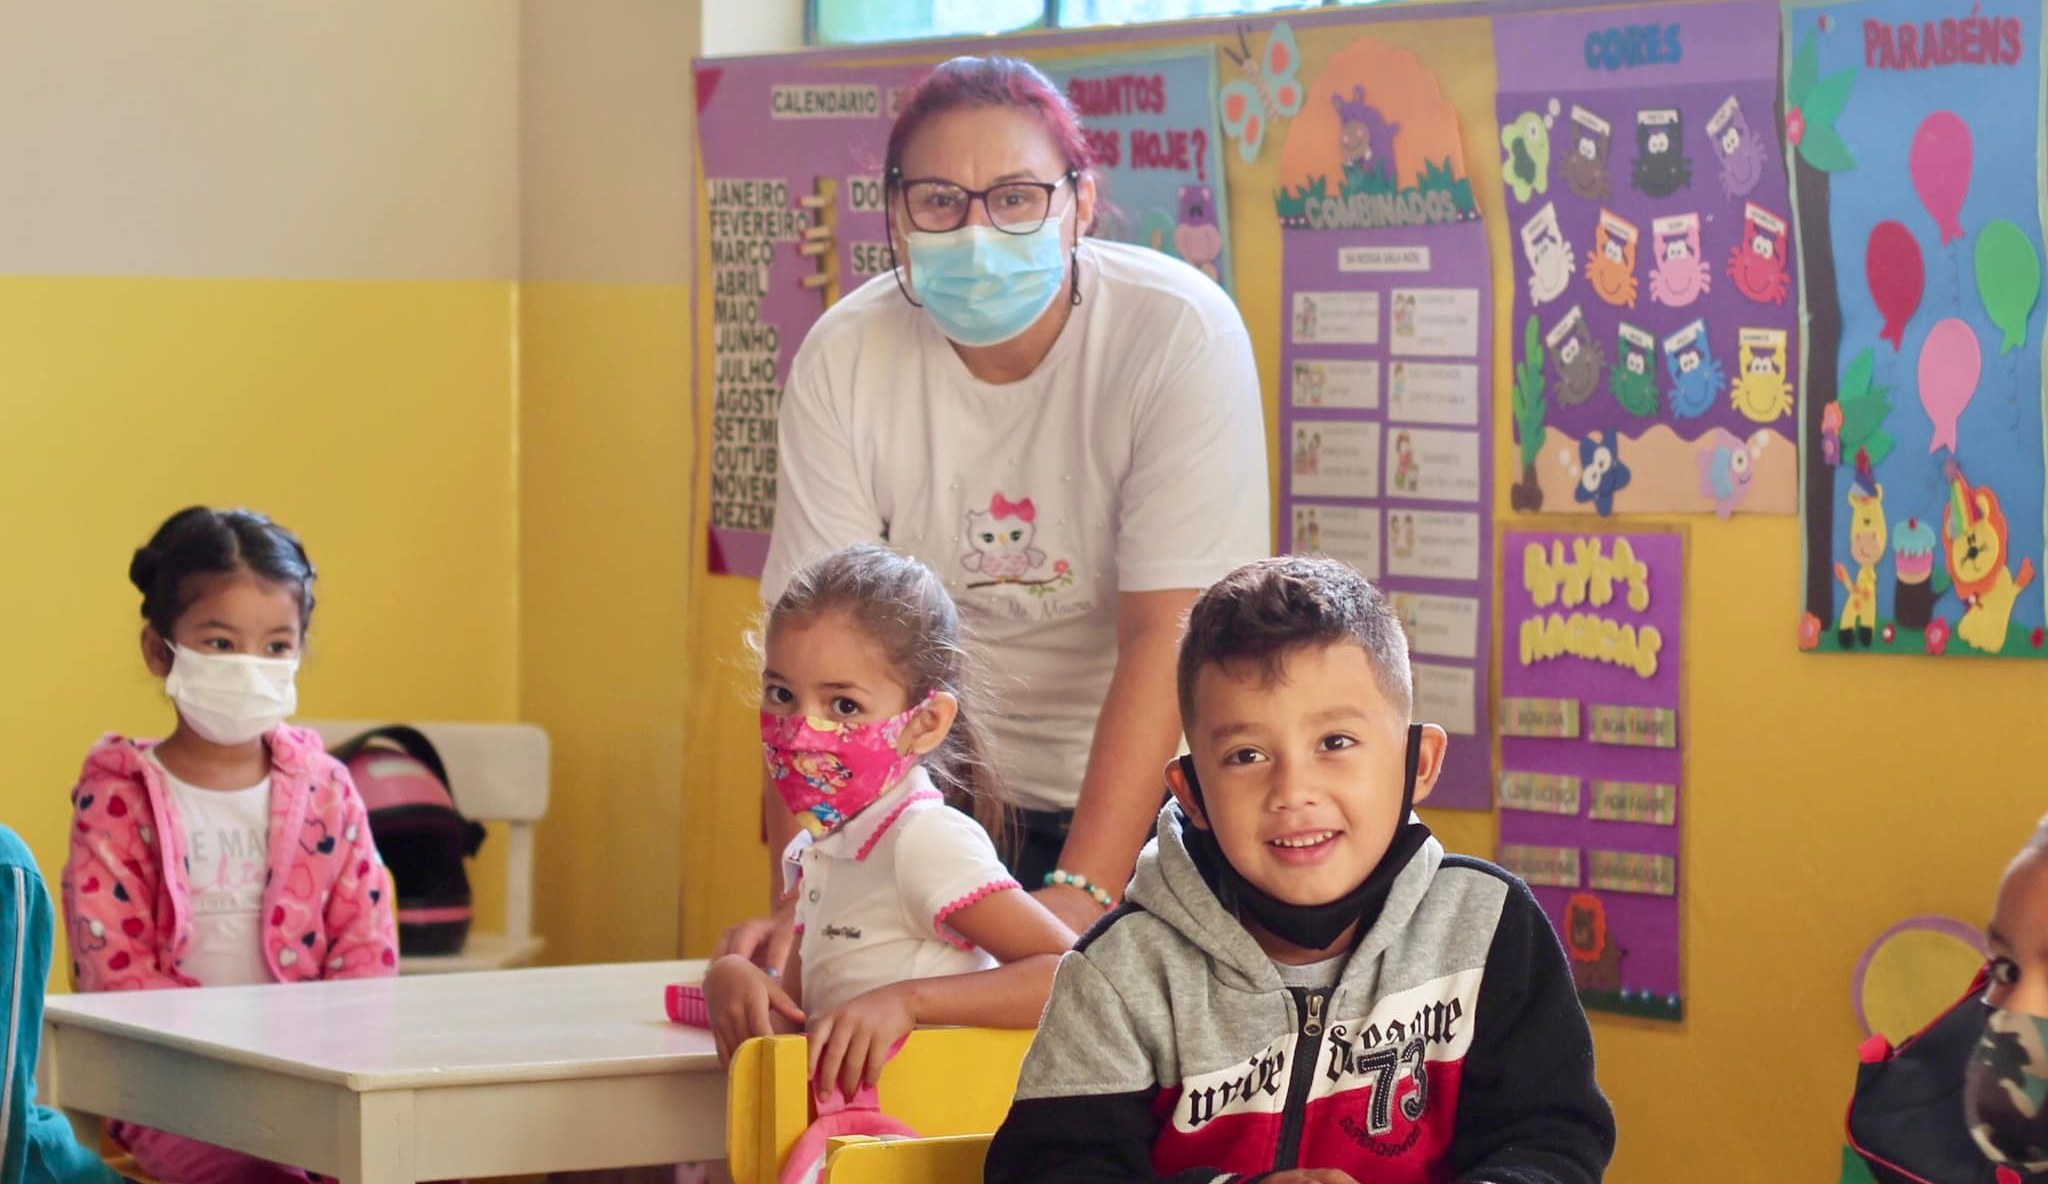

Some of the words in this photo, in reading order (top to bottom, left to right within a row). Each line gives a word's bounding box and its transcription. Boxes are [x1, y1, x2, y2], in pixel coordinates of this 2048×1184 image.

[1584, 22, 1683, 71] CORES
[1863, 2, 2023, 71] PARABÉNS
[1069, 74, 1167, 116] QUANTOS
[710, 180, 788, 207] JANEIRO
[1305, 188, 1457, 229] COMBINADOS
[710, 211, 809, 238] FEVEREIRO
[711, 240, 774, 267] MARÇO
[715, 270, 767, 297] ABRIL
[715, 300, 758, 324] MAIO
[716, 328, 778, 353] JUNHO
[716, 358, 776, 383] JULHO
[715, 388, 784, 414] AGOST
[714, 417, 778, 442] SETEM
[1355, 1035, 1428, 1136] 73
